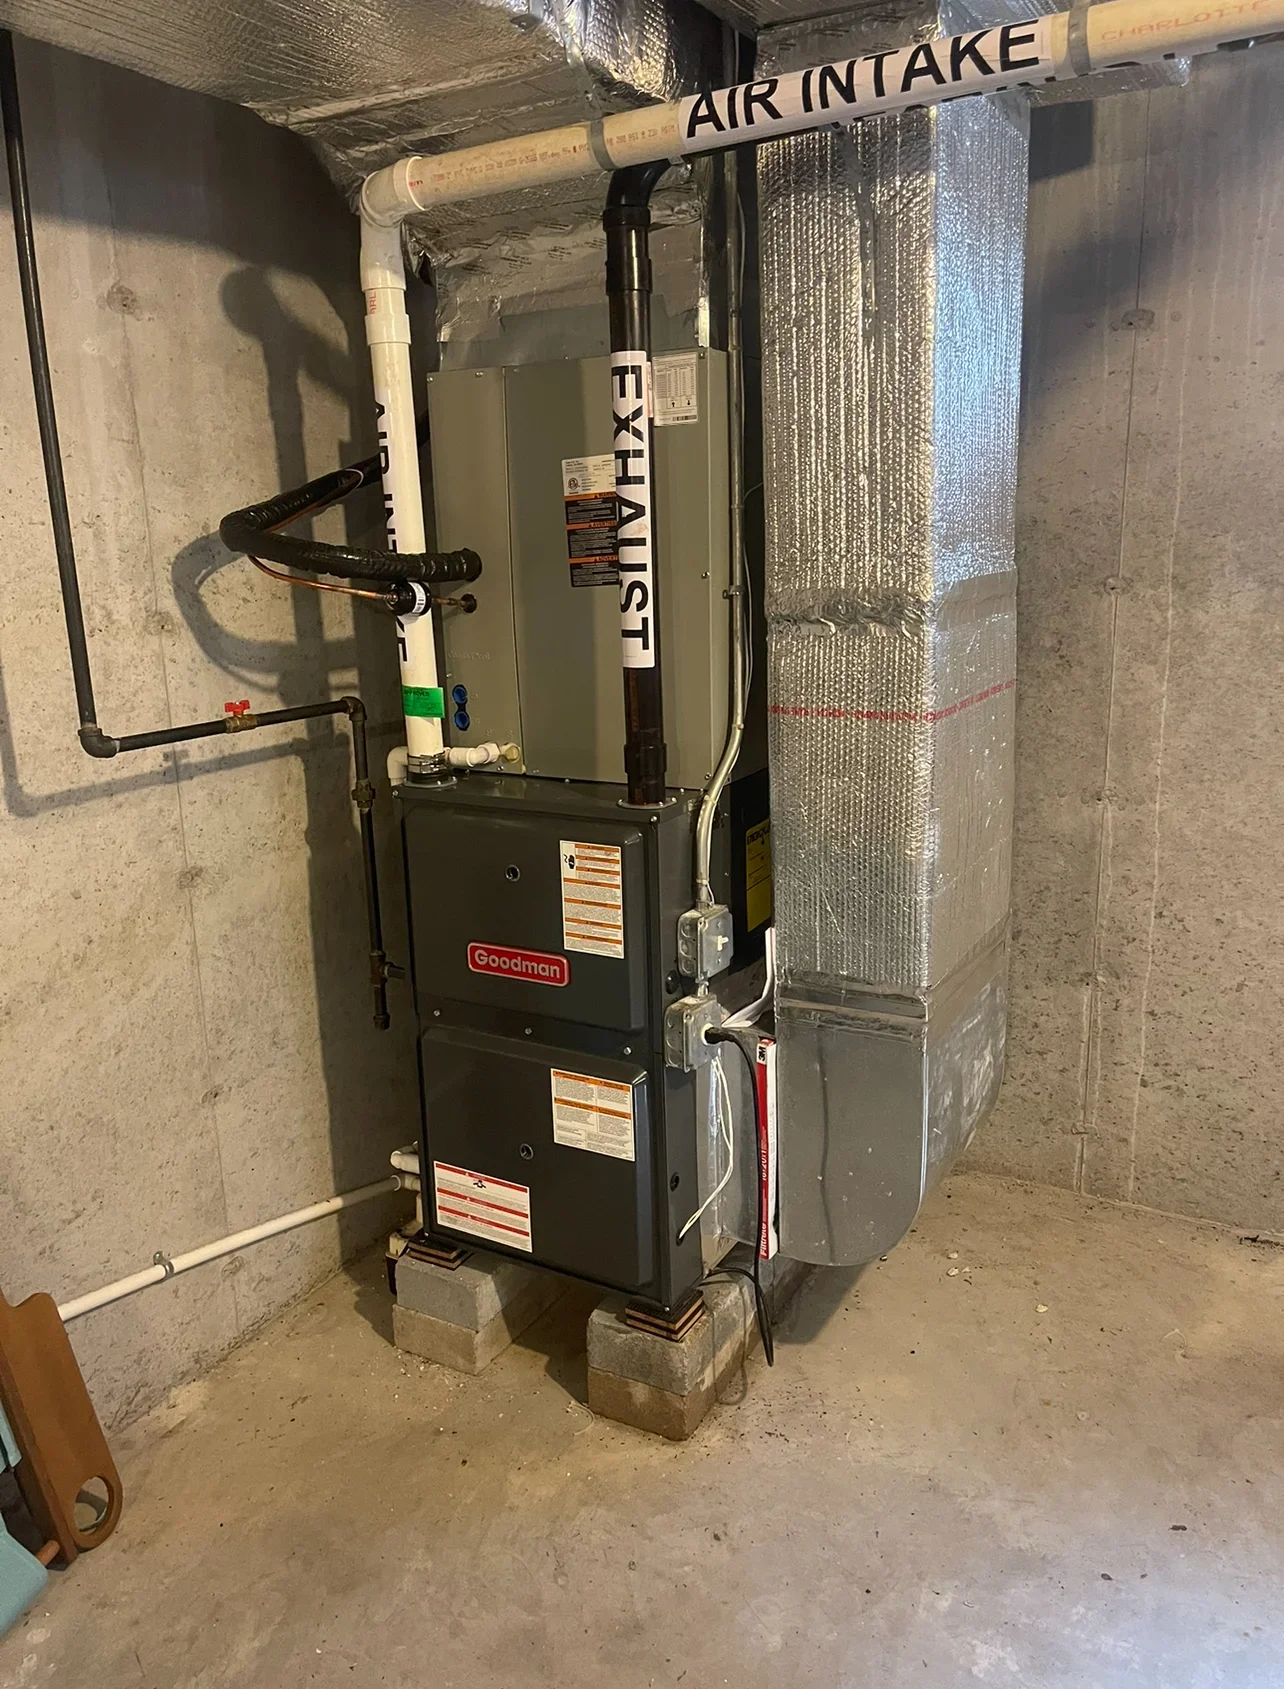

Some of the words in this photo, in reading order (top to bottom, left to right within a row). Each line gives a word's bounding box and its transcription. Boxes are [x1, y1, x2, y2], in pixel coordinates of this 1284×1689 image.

[1101, 0, 1270, 41] CHARLOTTE
[686, 78, 778, 138] AIR
[800, 18, 1040, 113] INTAKE
[611, 364, 650, 651] EXHAUST
[474, 949, 561, 979] Goodman
[758, 1046, 766, 1061] 3M
